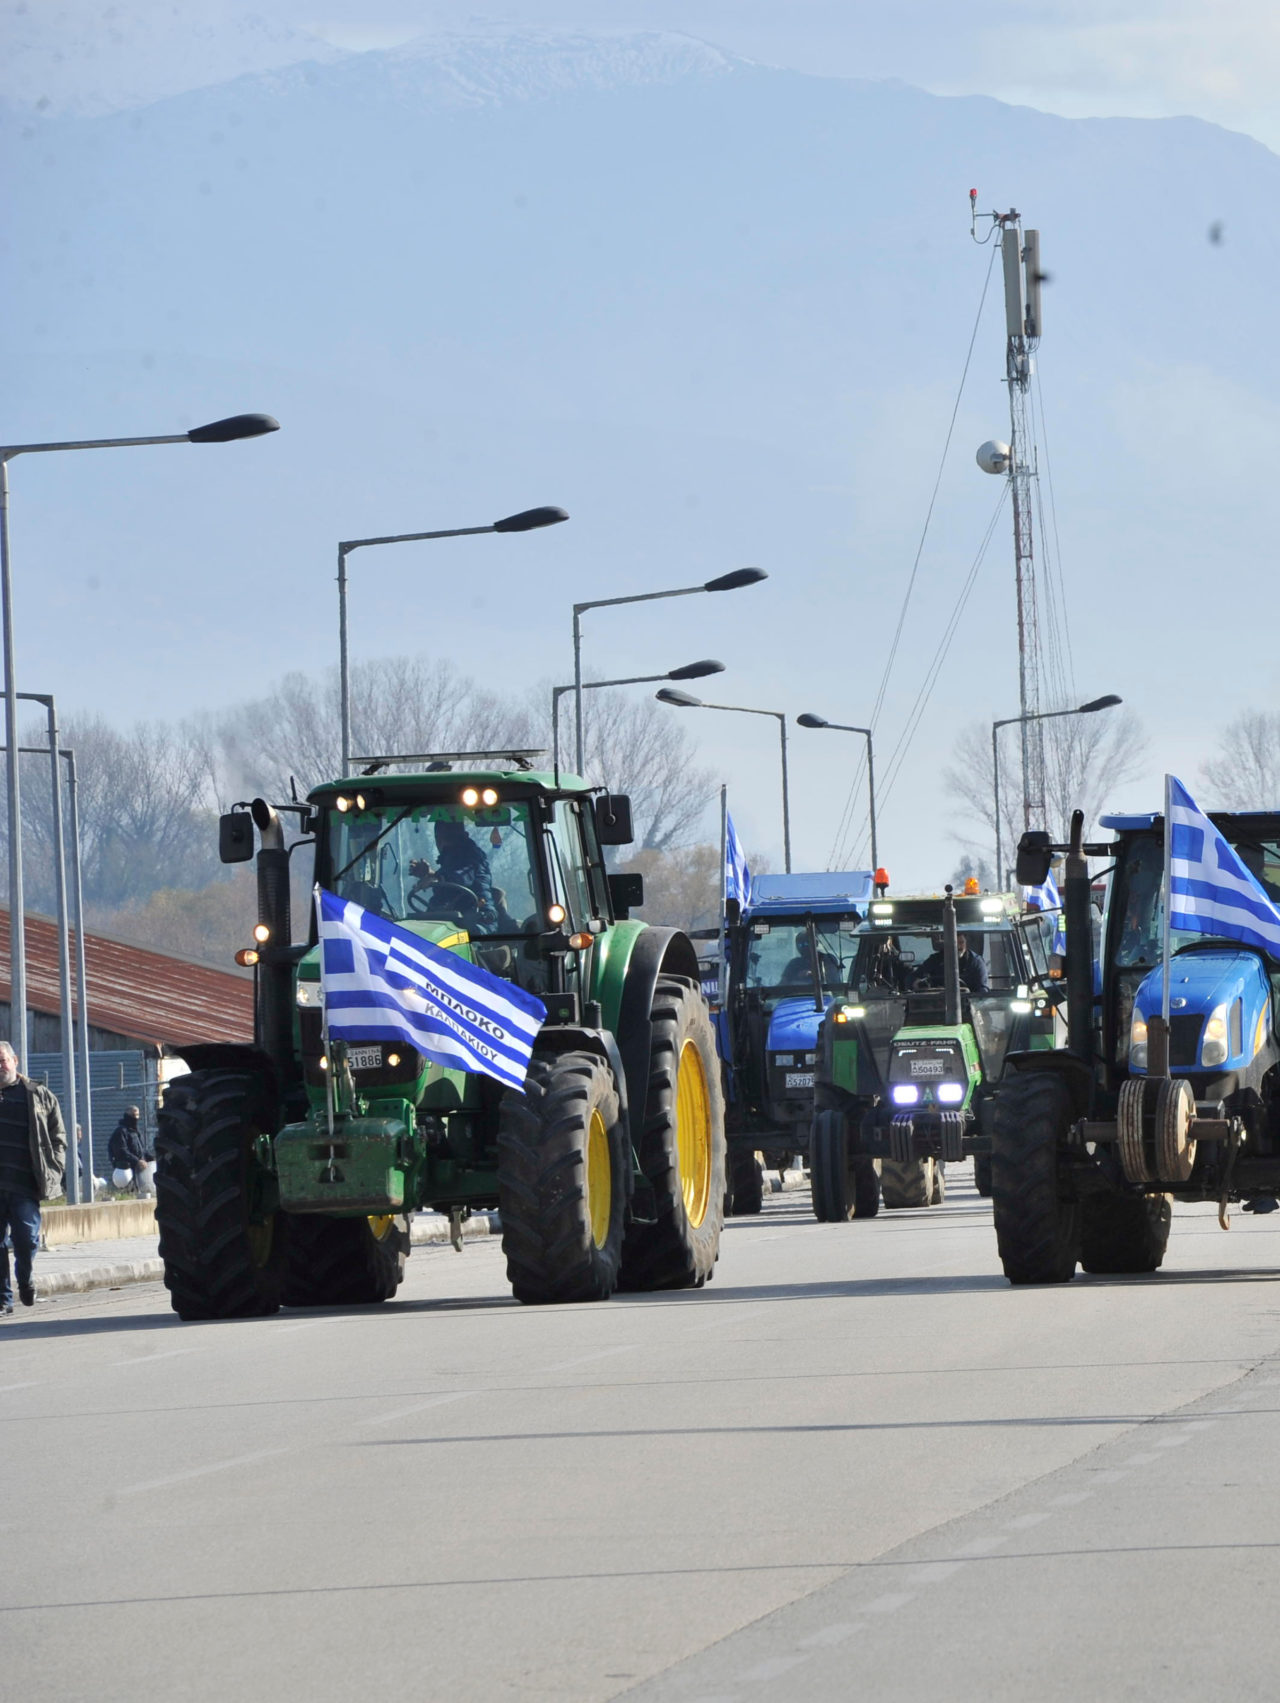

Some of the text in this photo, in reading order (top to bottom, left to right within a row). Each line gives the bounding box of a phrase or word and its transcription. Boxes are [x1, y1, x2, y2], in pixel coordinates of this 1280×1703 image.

[425, 982, 504, 1040] ΜΠΛΟΚΟ
[425, 1003, 498, 1061] ΚΑΛΠΑΚΙΟΥ
[347, 1054, 381, 1067] 51886
